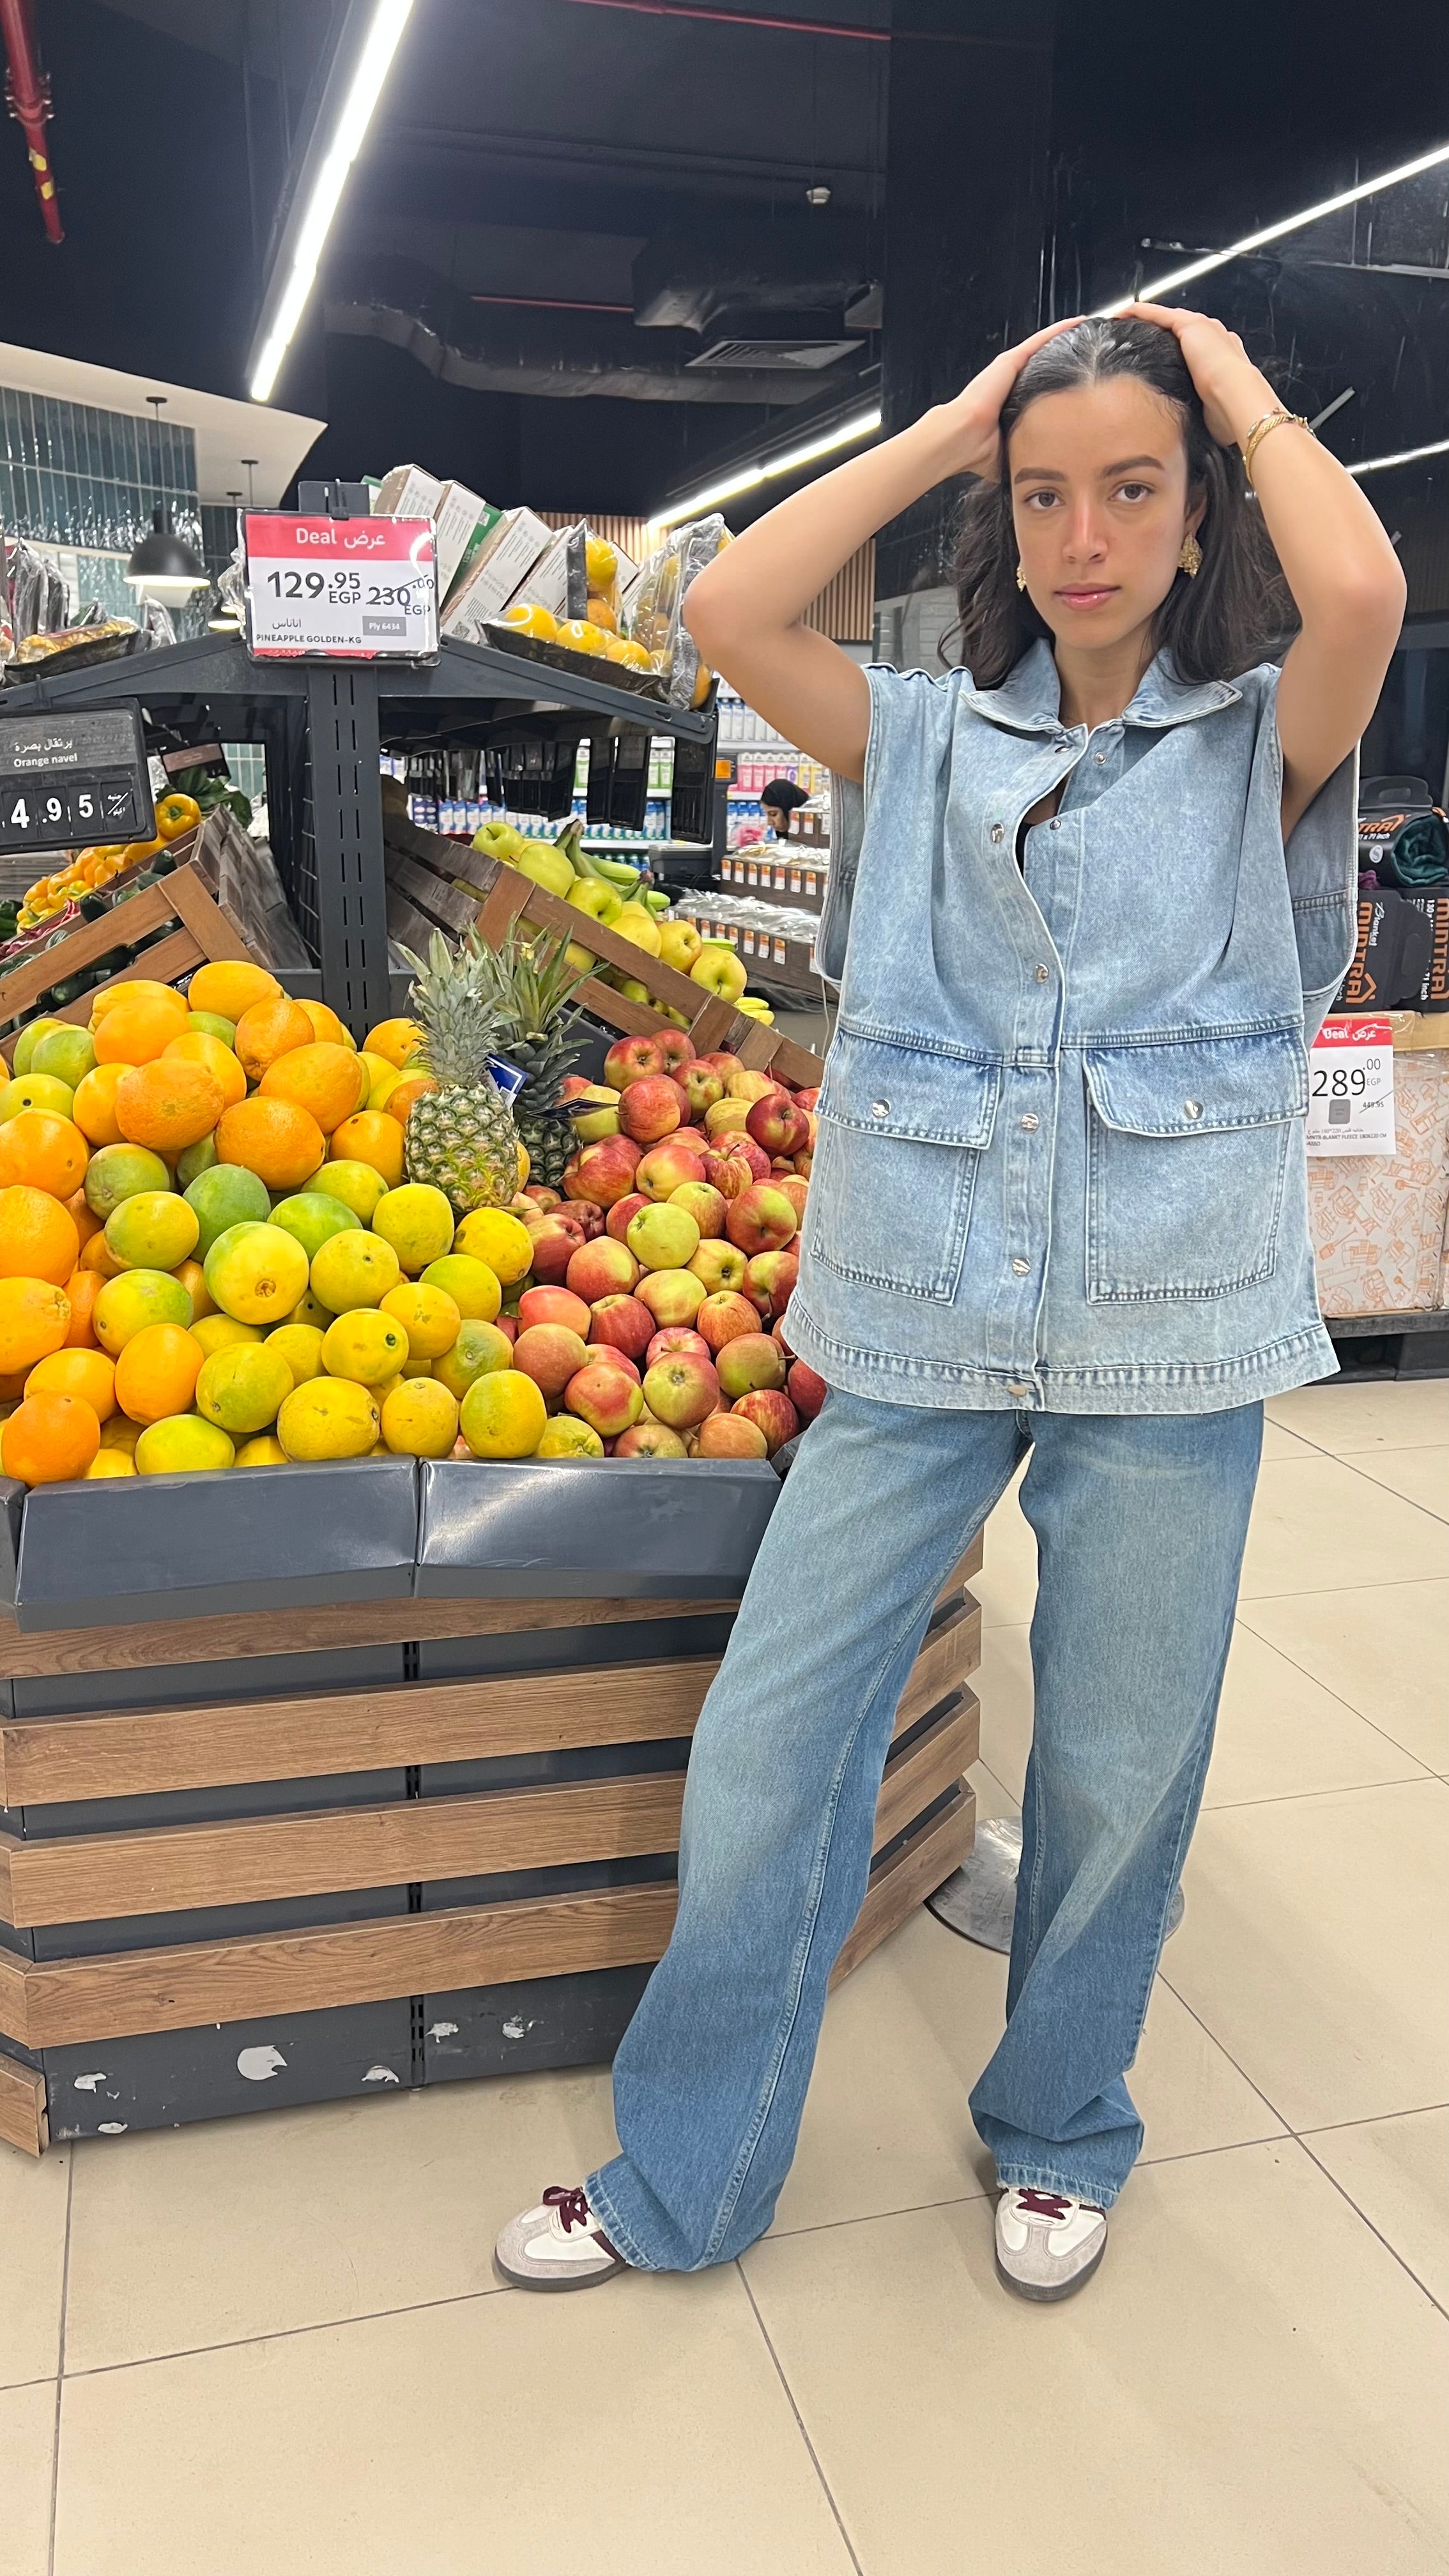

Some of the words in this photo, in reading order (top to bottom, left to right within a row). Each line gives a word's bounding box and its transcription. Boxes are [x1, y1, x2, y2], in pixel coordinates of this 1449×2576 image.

[296, 528, 337, 544] Deal
[344, 531, 386, 549] عرض
[329, 592, 361, 604] EGP
[272, 618, 302, 630] اناناس
[369, 622, 381, 631] Ply
[382, 622, 401, 631] 6434
[256, 634, 305, 643] PINEAPPLE
[307, 635, 362, 645] GOLDEN-KG
[13, 757, 49, 767] Orange
[51, 753, 78, 764] navel
[1346, 901, 1374, 998] MINTRA
[1430, 898, 1449, 994] MINTRA
[1322, 1028, 1349, 1039] Deal
